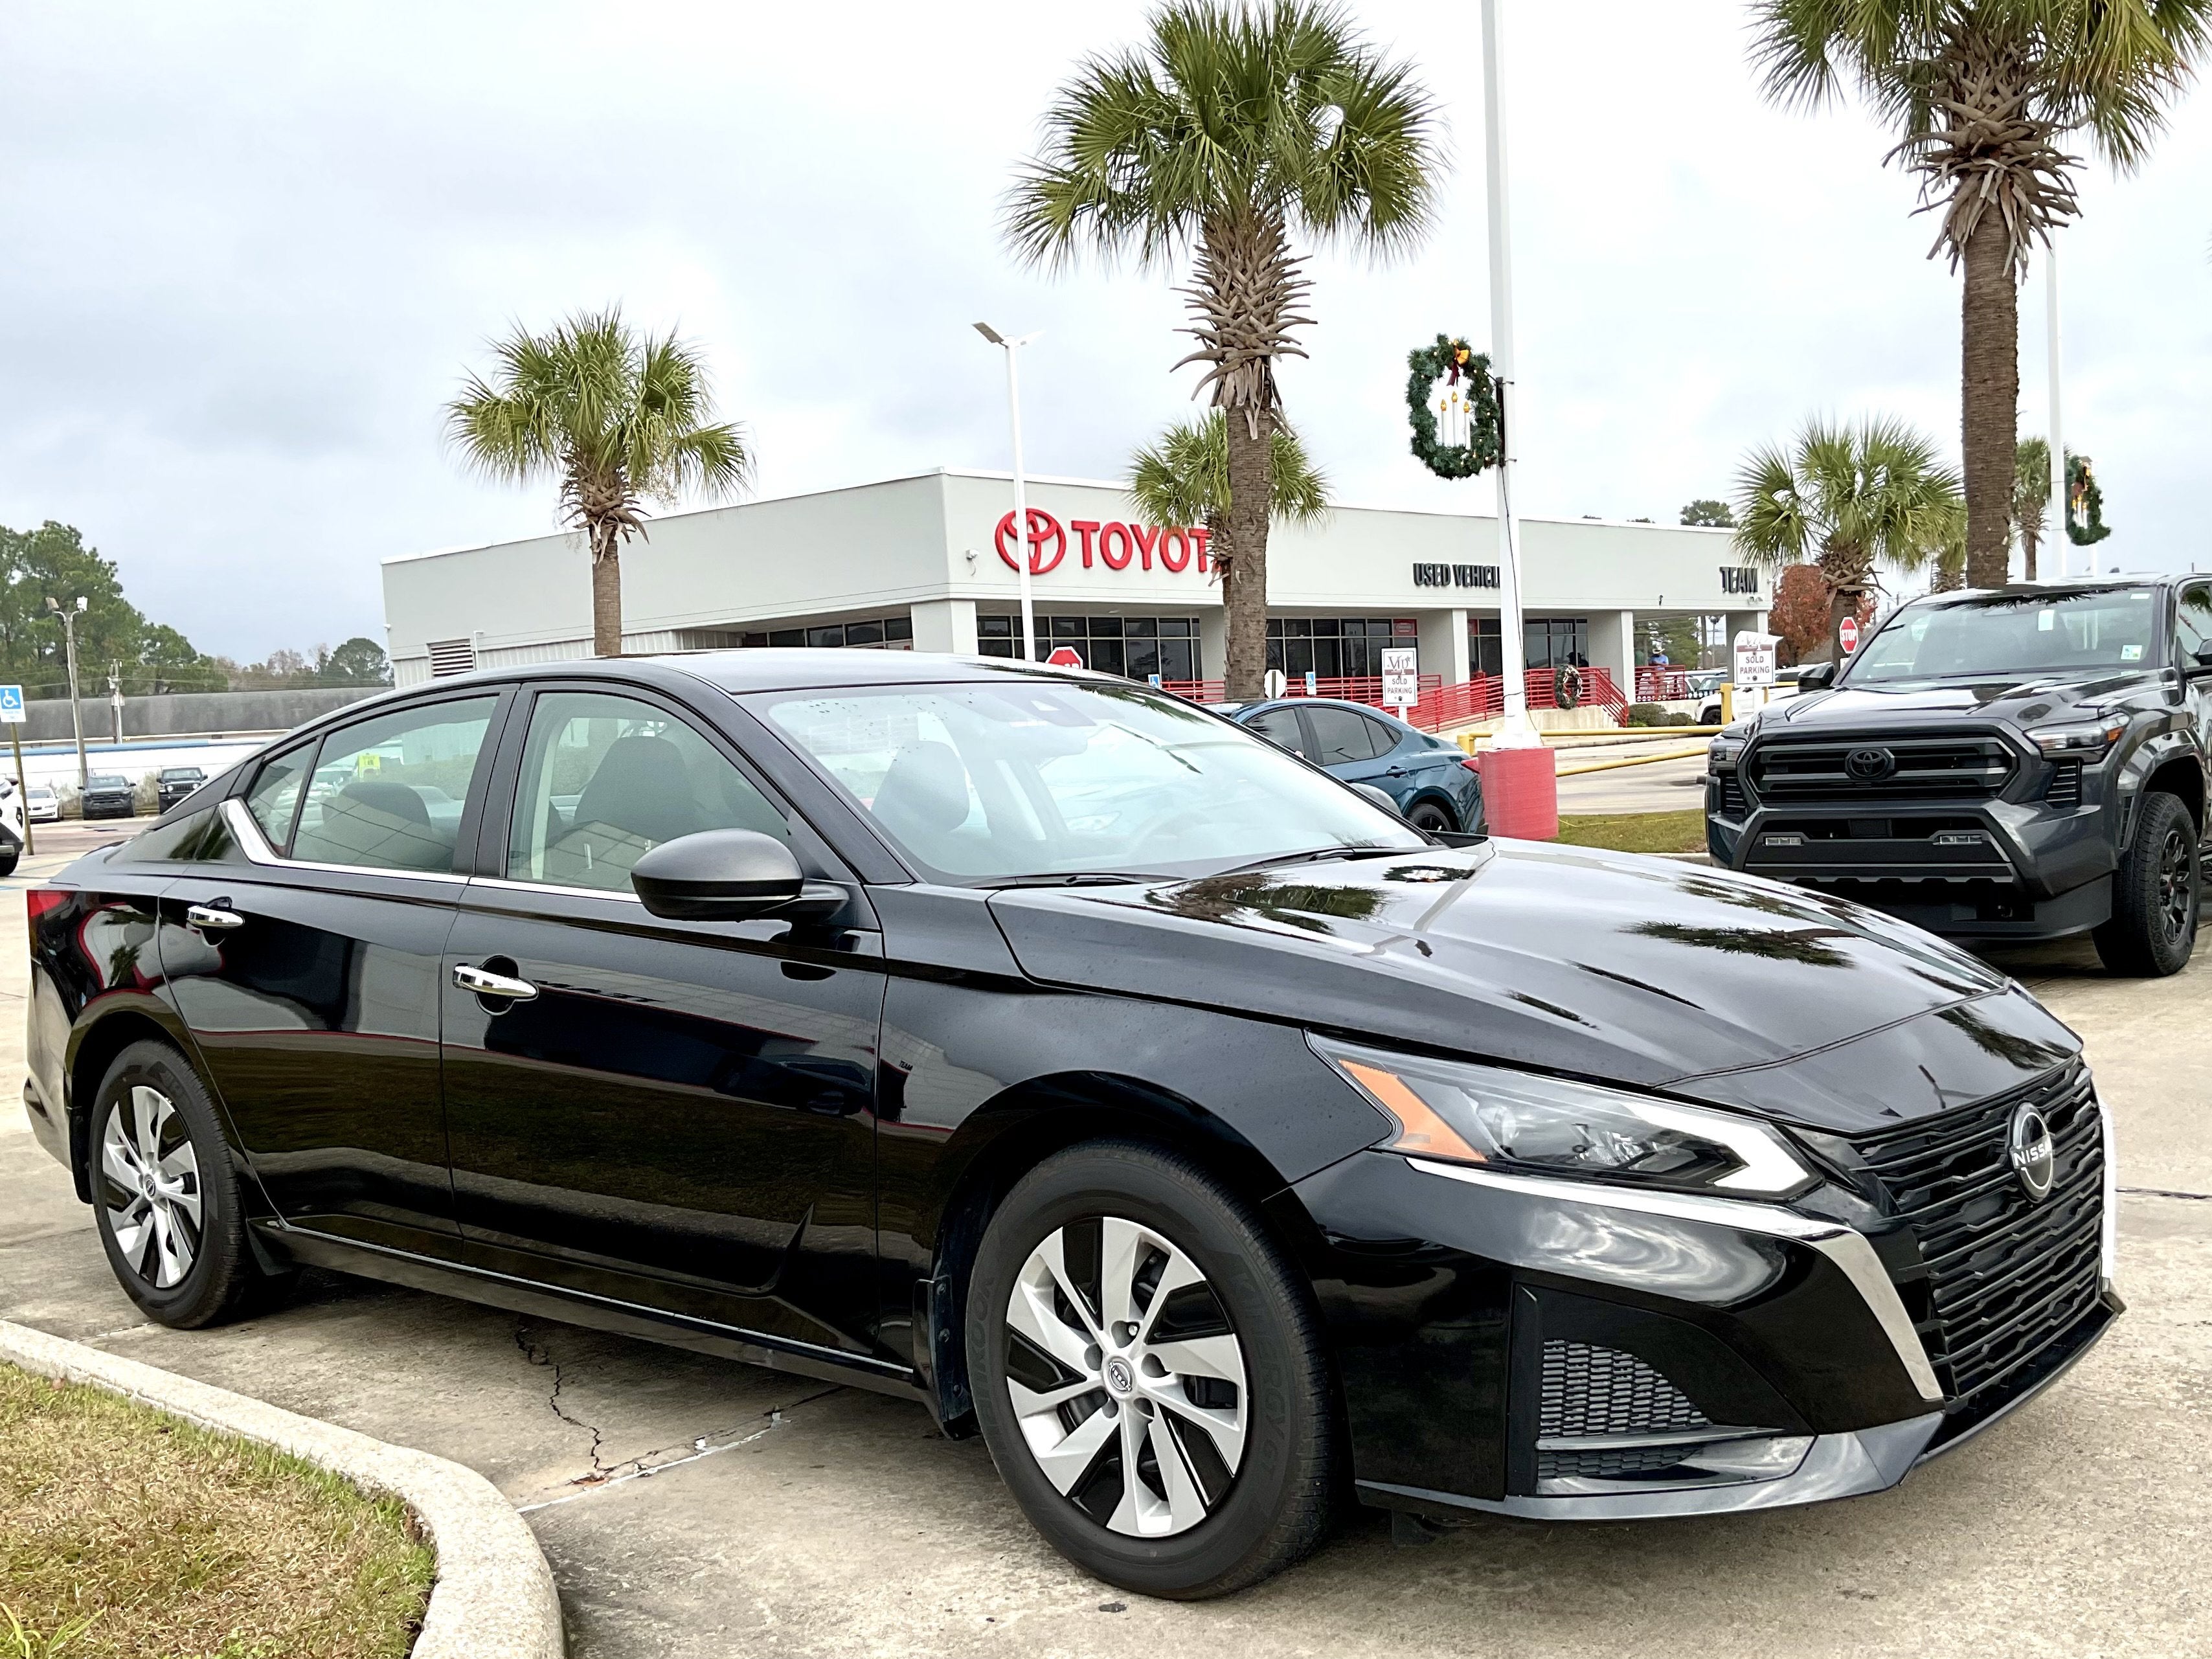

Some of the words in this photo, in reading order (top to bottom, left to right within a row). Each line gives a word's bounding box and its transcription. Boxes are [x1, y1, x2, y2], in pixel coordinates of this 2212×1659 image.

[1071, 520, 1221, 573] TOYOT
[1413, 563, 1450, 586] USED
[1452, 565, 1500, 589] VEHICL
[1720, 567, 1758, 592] TEAM
[1842, 629, 1857, 641] STOP
